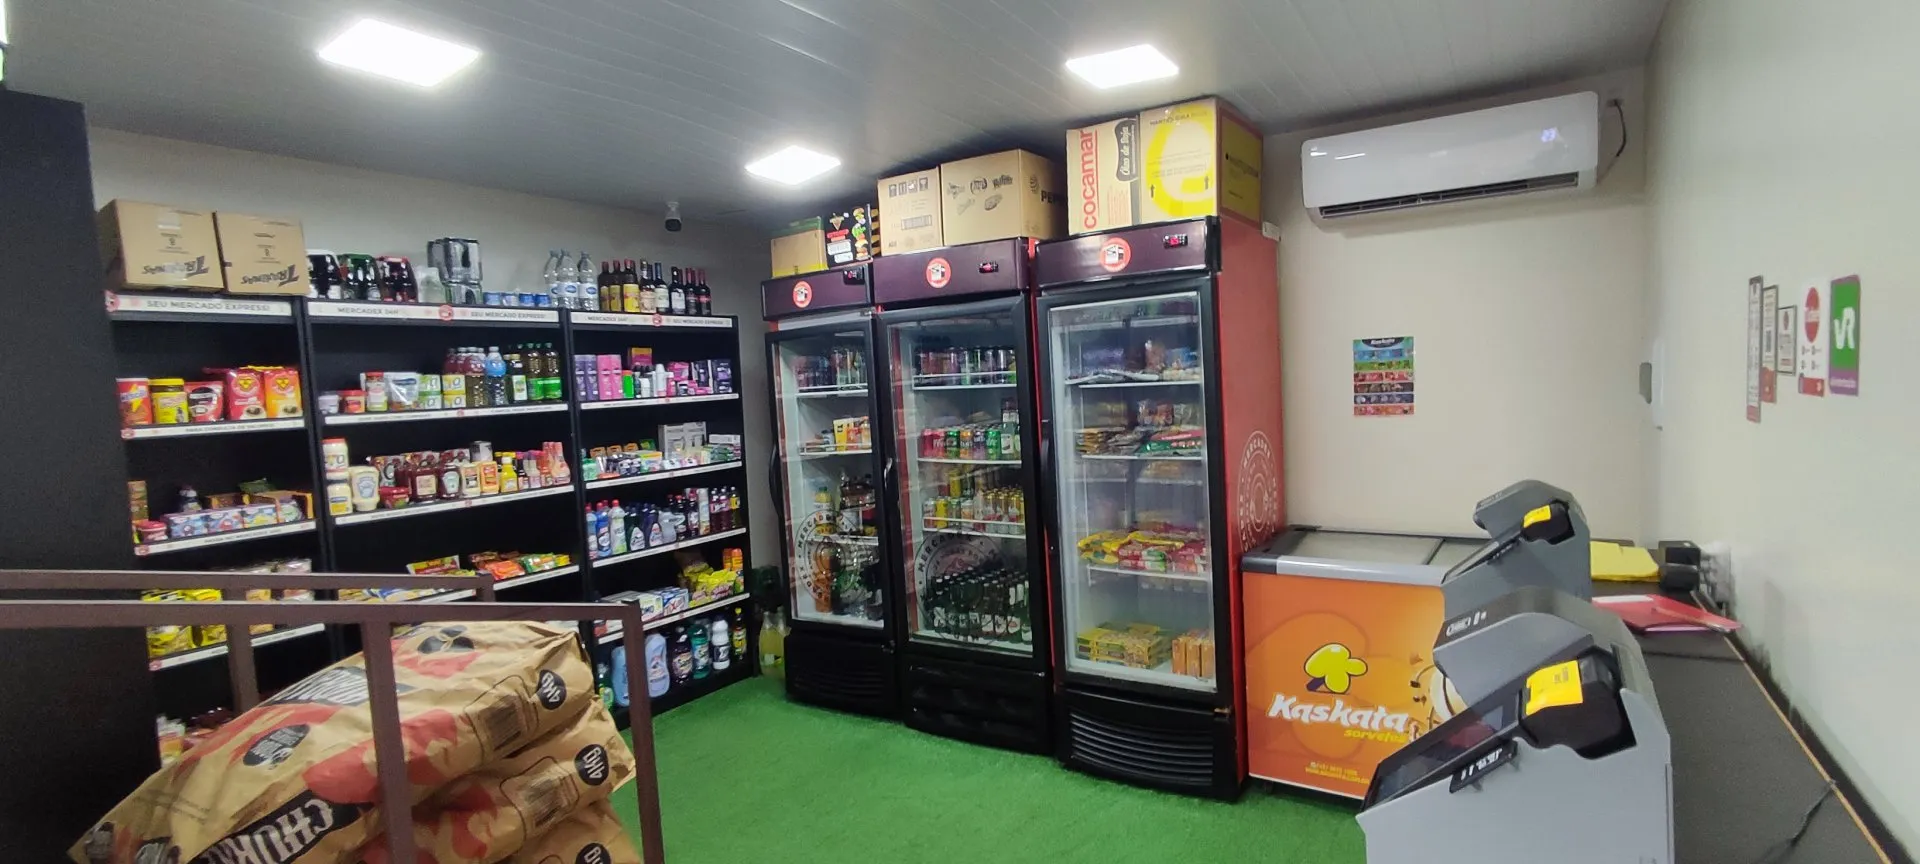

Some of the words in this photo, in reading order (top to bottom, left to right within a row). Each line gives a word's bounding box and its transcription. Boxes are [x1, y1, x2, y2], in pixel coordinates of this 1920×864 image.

[1120, 145, 1130, 156] de
[1080, 129, 1097, 230] cocamar
[147, 299, 168, 308] SEU
[169, 301, 223, 310] MERCADO
[224, 303, 271, 312] EXPRESS!
[1268, 692, 1410, 734] Kaskata
[583, 745, 604, 781] 4Kg
